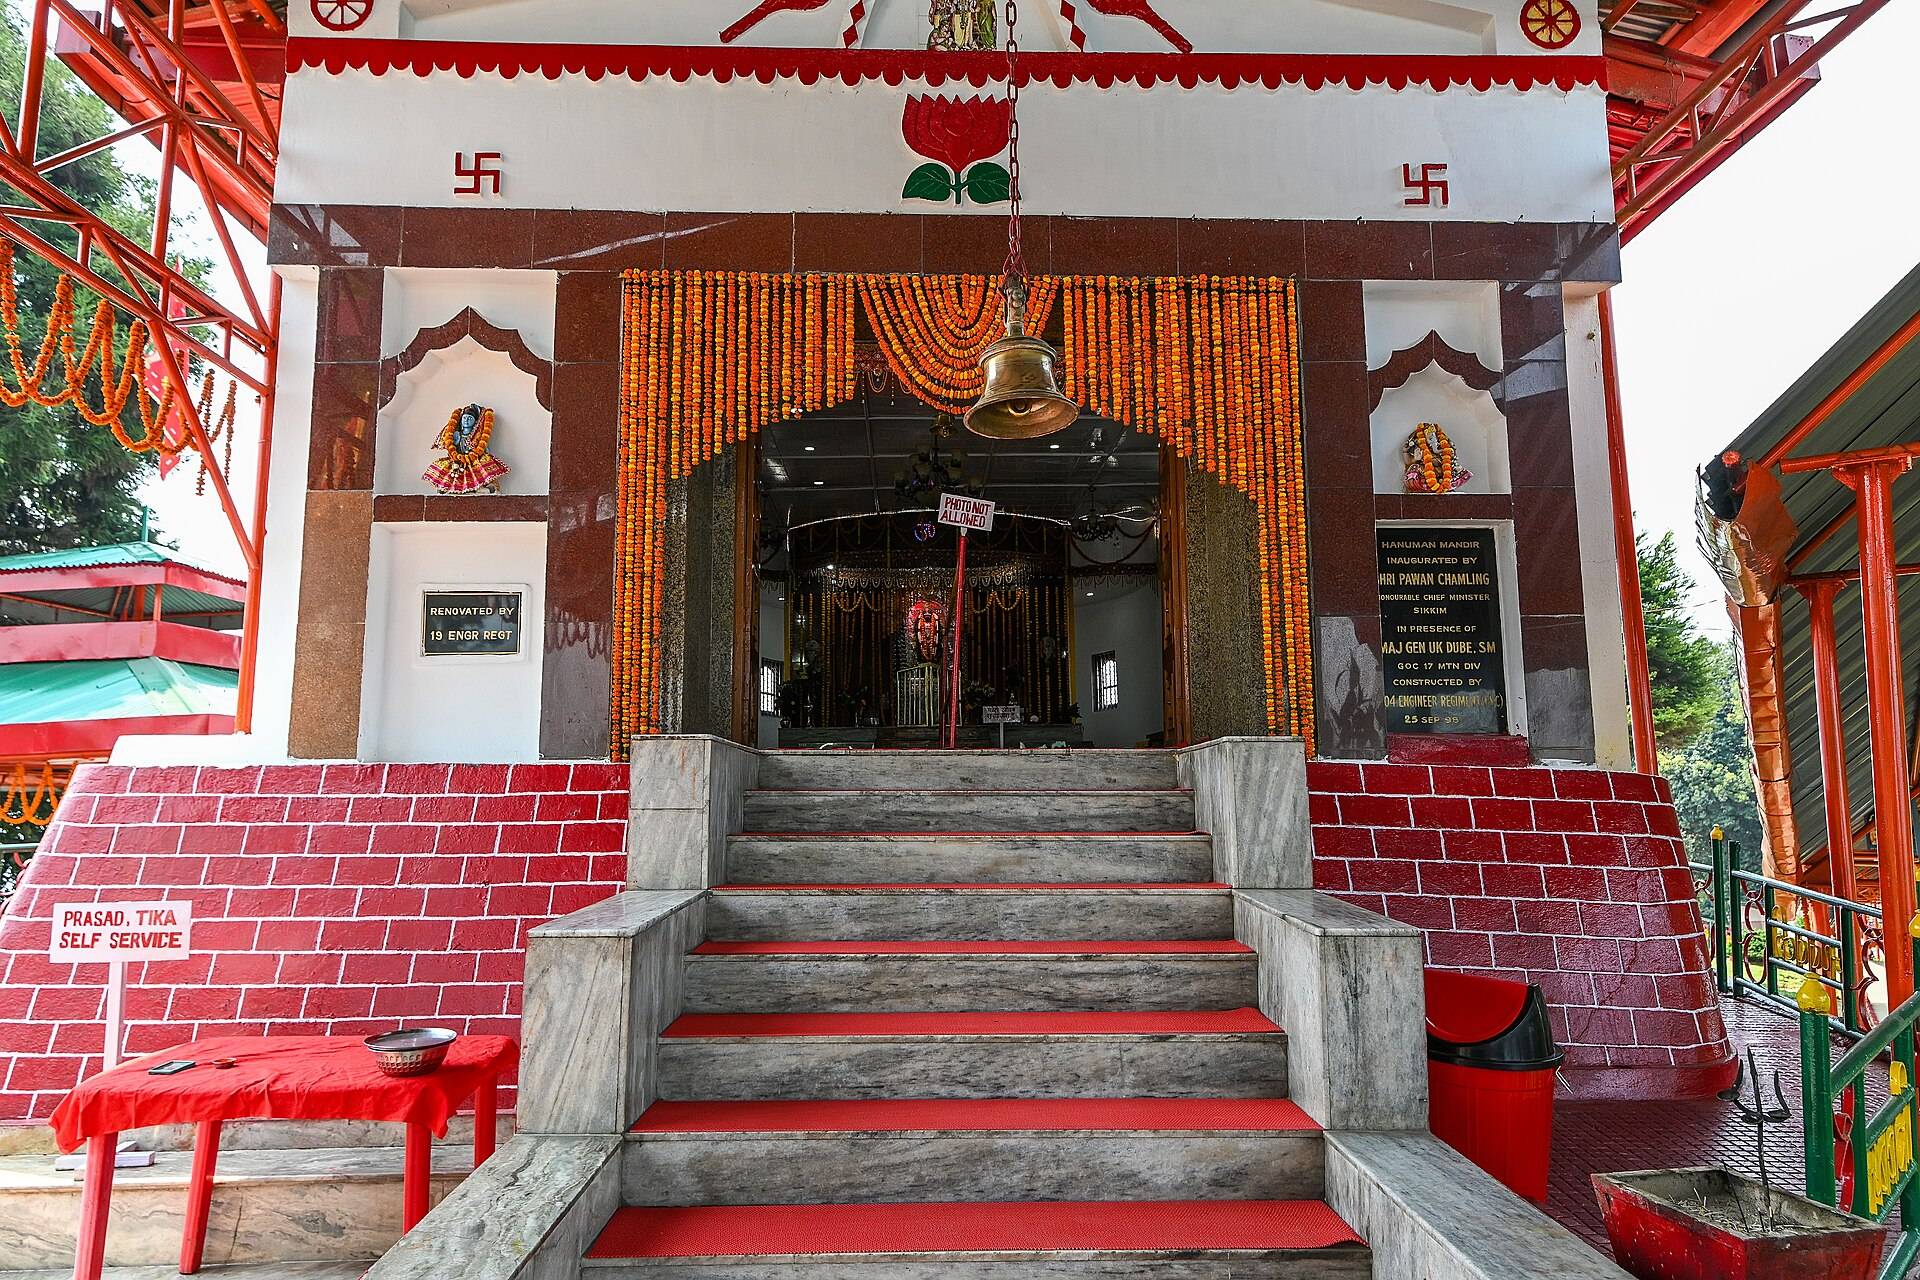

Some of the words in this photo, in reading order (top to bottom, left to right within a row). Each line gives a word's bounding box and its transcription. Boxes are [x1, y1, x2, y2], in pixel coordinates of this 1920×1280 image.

[944, 497, 971, 512] PHOTO
[971, 501, 991, 516] NOT
[940, 510, 986, 528] ALLOWED
[1381, 541, 1436, 549] HANUMAN
[1439, 541, 1480, 549] MANDIR
[1379, 573, 1396, 586] HRI
[1399, 573, 1434, 586] PAWAN
[1438, 573, 1490, 586] CHAMLING
[430, 607, 493, 616] RENOVATED
[499, 607, 515, 615] BY
[430, 631, 443, 641] 19
[448, 631, 479, 640] ENGR
[483, 630, 513, 640] REGT
[1397, 625, 1407, 633] IN
[1410, 625, 1461, 633] PRESENCE
[1381, 641, 1403, 654] MAJ
[1405, 641, 1426, 654] GEN
[1428, 641, 1443, 654] UK
[1479, 641, 1496, 654] SM
[1392, 678, 1463, 686] CONSTRUCTED
[1468, 678, 1482, 686] BY
[1384, 695, 1396, 708] 04
[1398, 695, 1438, 708] ENGINEER
[1404, 714, 1418, 724] 25
[63, 910, 130, 928] PRASAD,
[136, 909, 177, 926] TIKA
[59, 932, 102, 949] SELF
[109, 932, 183, 949] SERVICE
